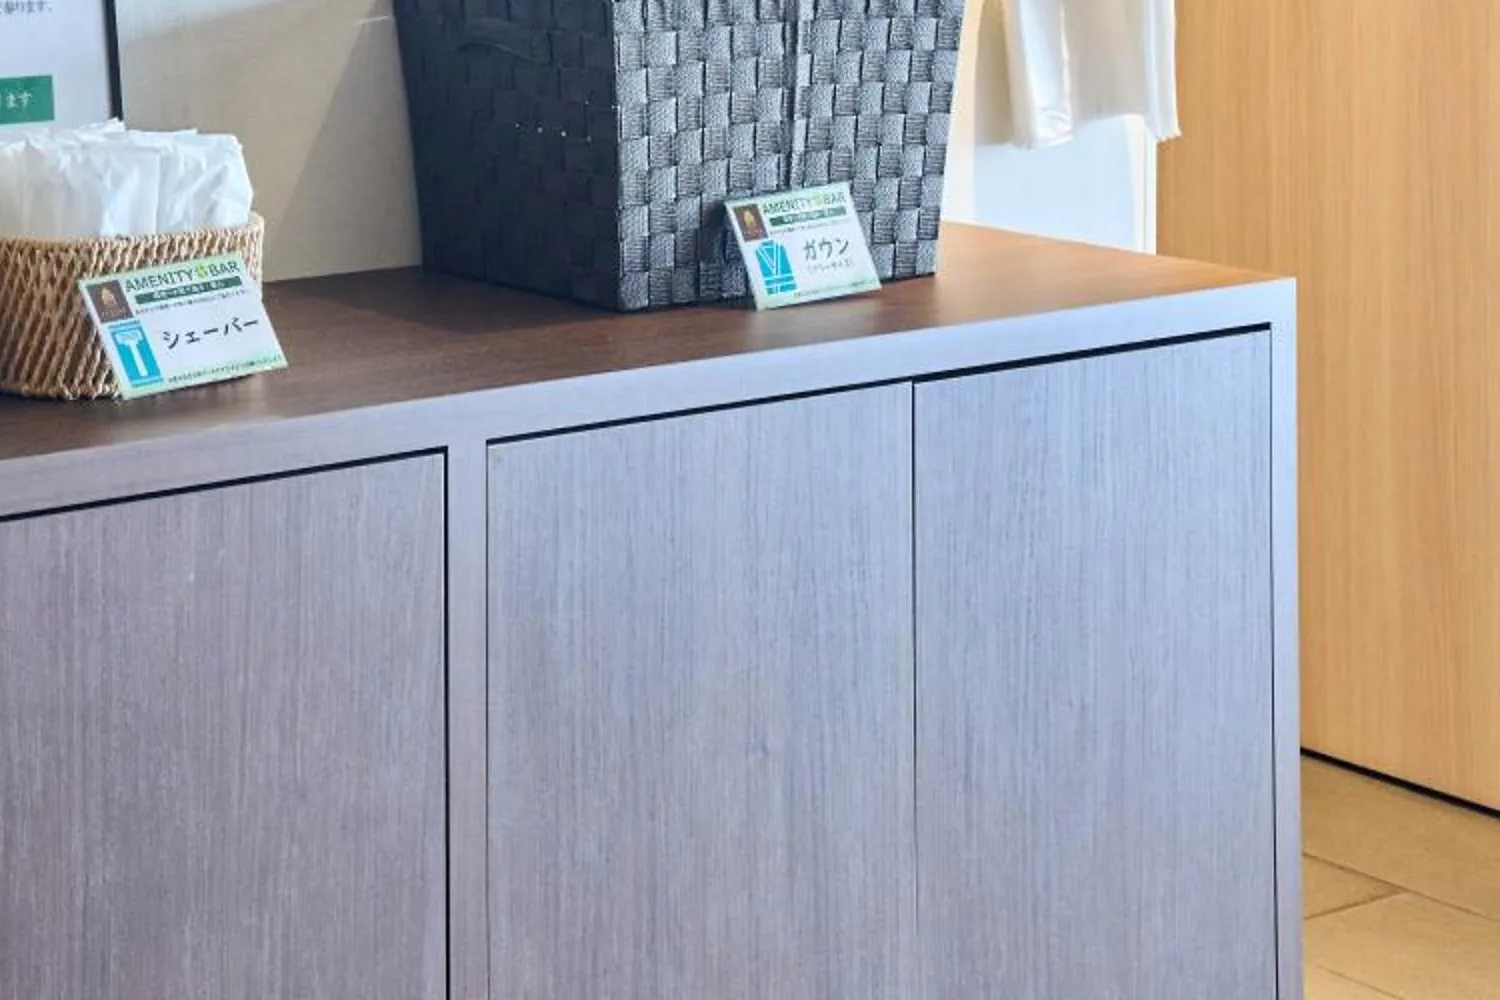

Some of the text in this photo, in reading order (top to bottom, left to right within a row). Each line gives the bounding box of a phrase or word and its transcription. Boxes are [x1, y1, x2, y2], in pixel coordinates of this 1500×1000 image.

[804, 237, 849, 261] ガウン
[125, 268, 193, 292] AMENITY
[208, 261, 240, 277] BAR
[163, 316, 259, 349] シェーバー
